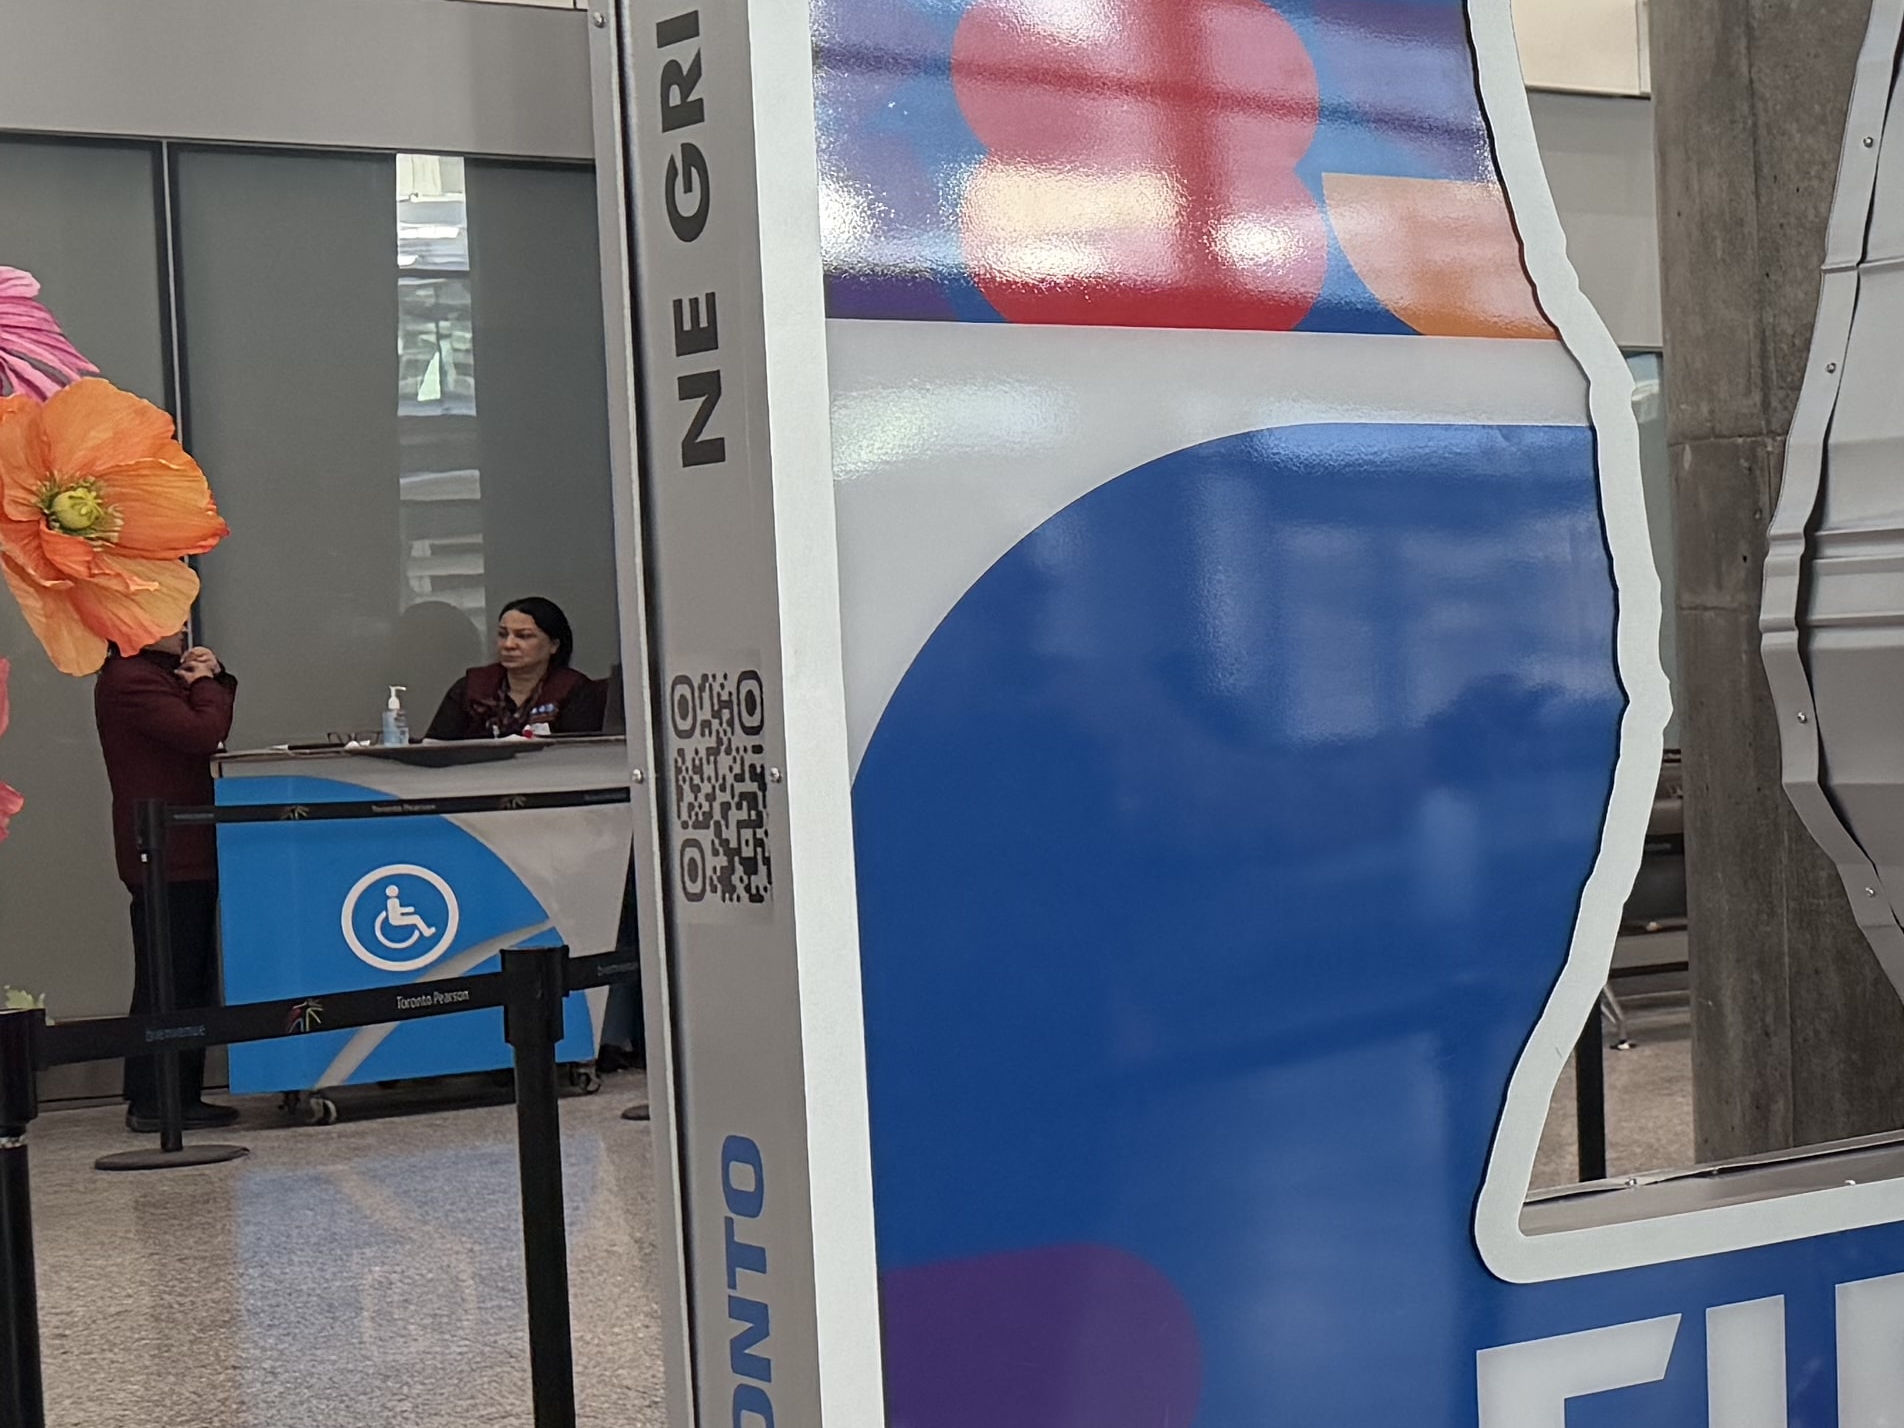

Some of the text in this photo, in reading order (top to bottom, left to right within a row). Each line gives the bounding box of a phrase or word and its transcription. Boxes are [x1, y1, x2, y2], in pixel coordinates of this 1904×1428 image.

[672, 291, 727, 469] NE
[396, 990, 470, 1010] Toronto Pearson
